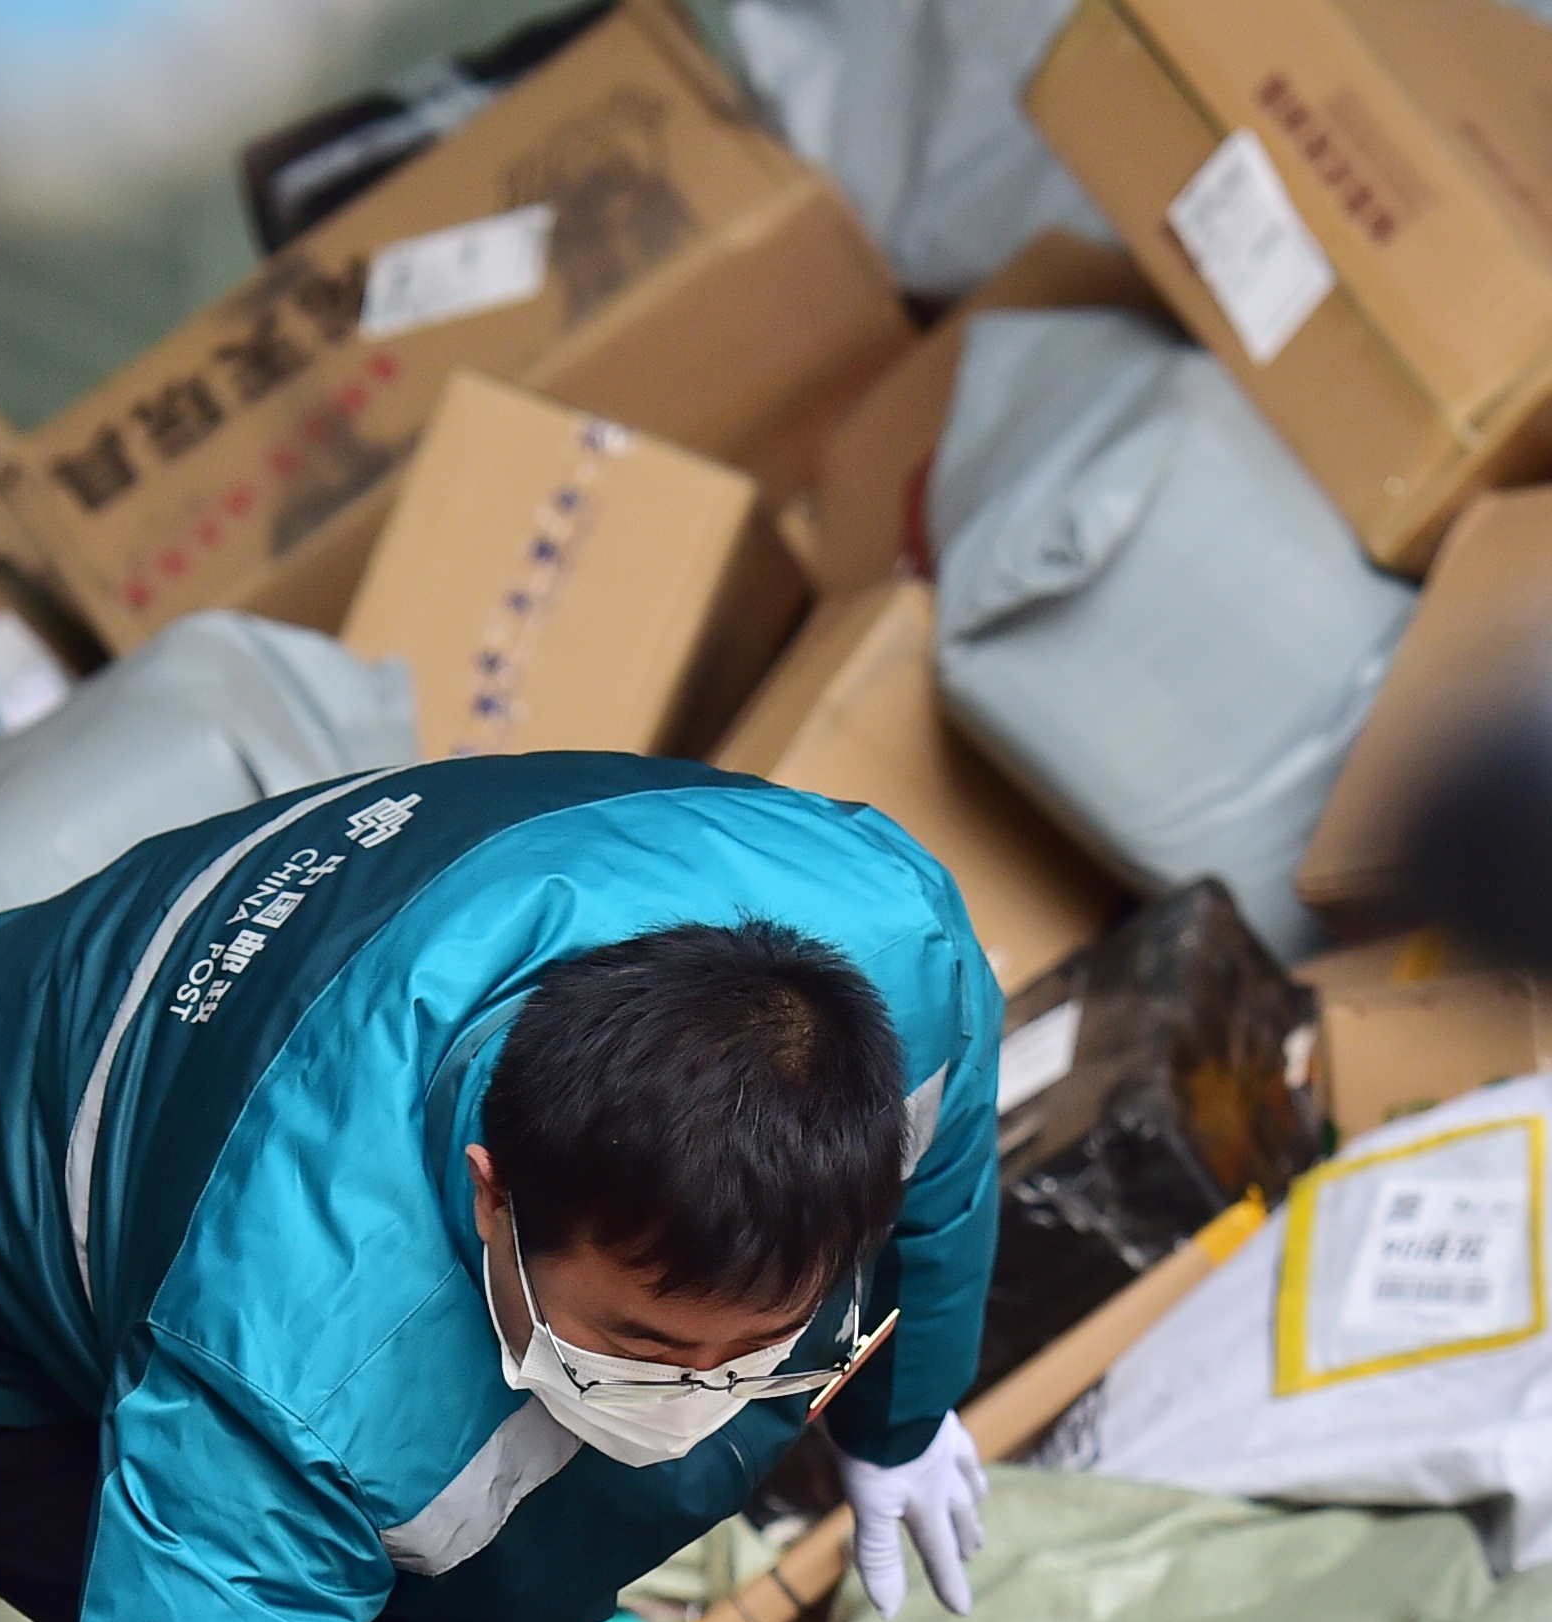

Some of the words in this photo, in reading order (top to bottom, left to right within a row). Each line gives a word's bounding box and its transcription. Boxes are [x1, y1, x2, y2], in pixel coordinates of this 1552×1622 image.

[226, 848, 319, 925] CHINA
[190, 855, 347, 1024] 中国邮政
[169, 942, 226, 1023] POST
